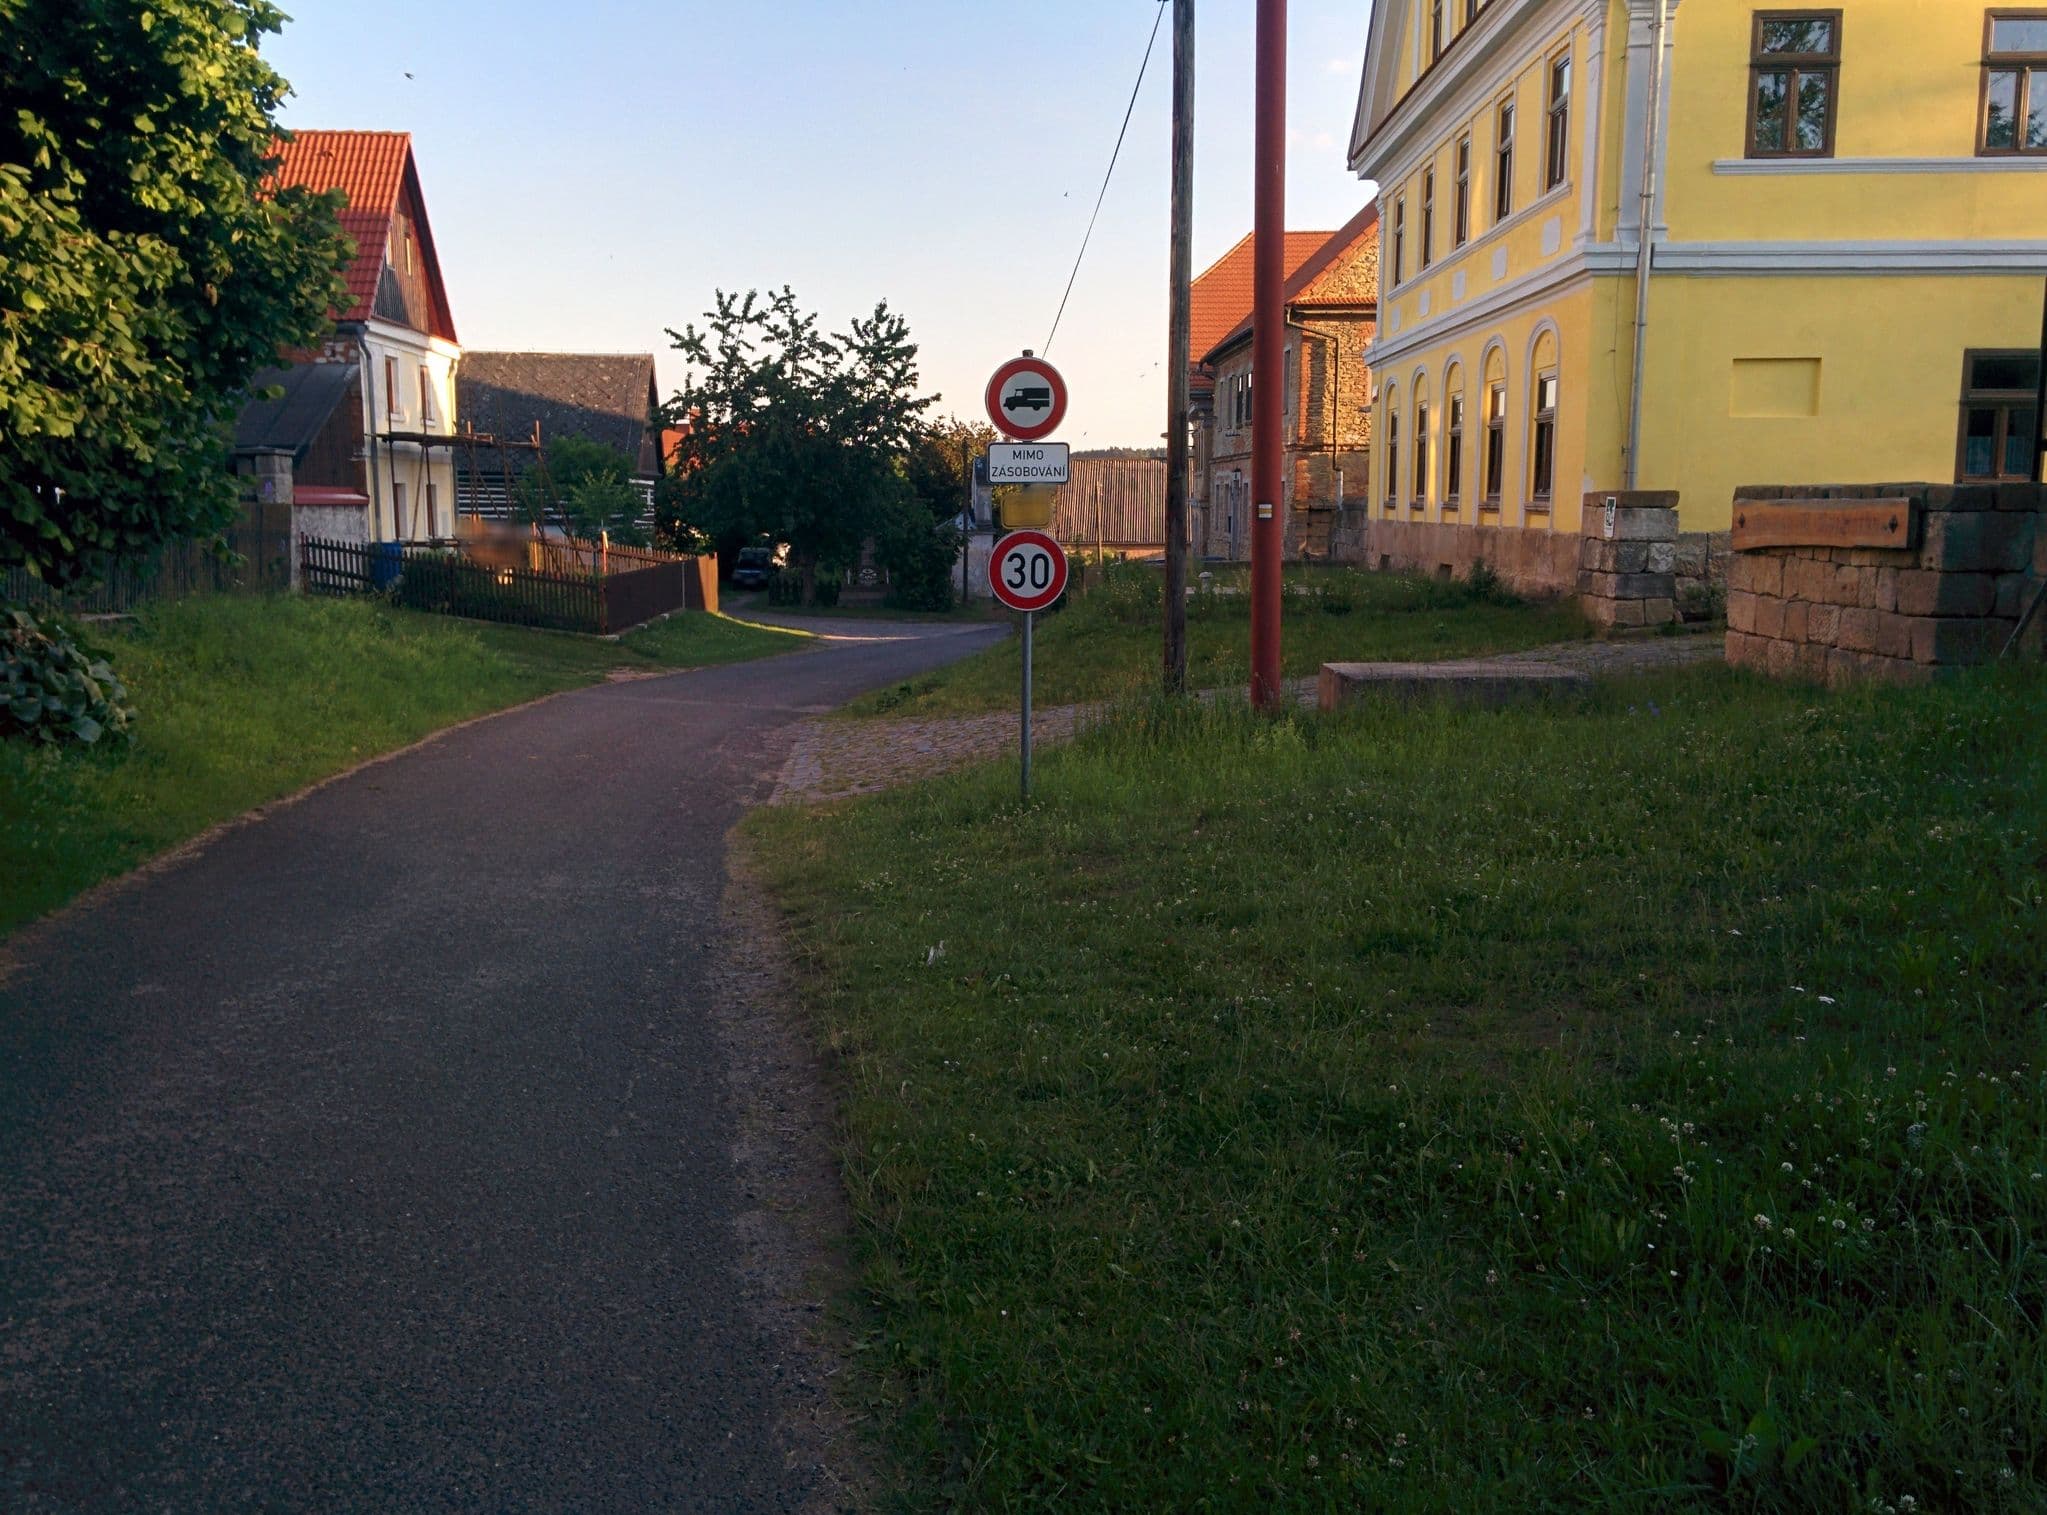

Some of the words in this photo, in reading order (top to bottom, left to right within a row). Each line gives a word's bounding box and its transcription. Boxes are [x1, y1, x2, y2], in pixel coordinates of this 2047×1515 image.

[1013, 450, 1044, 460] MIMO
[992, 464, 1065, 477] ZÁSOBOVÁNÍ
[1007, 553, 1049, 589] 30
